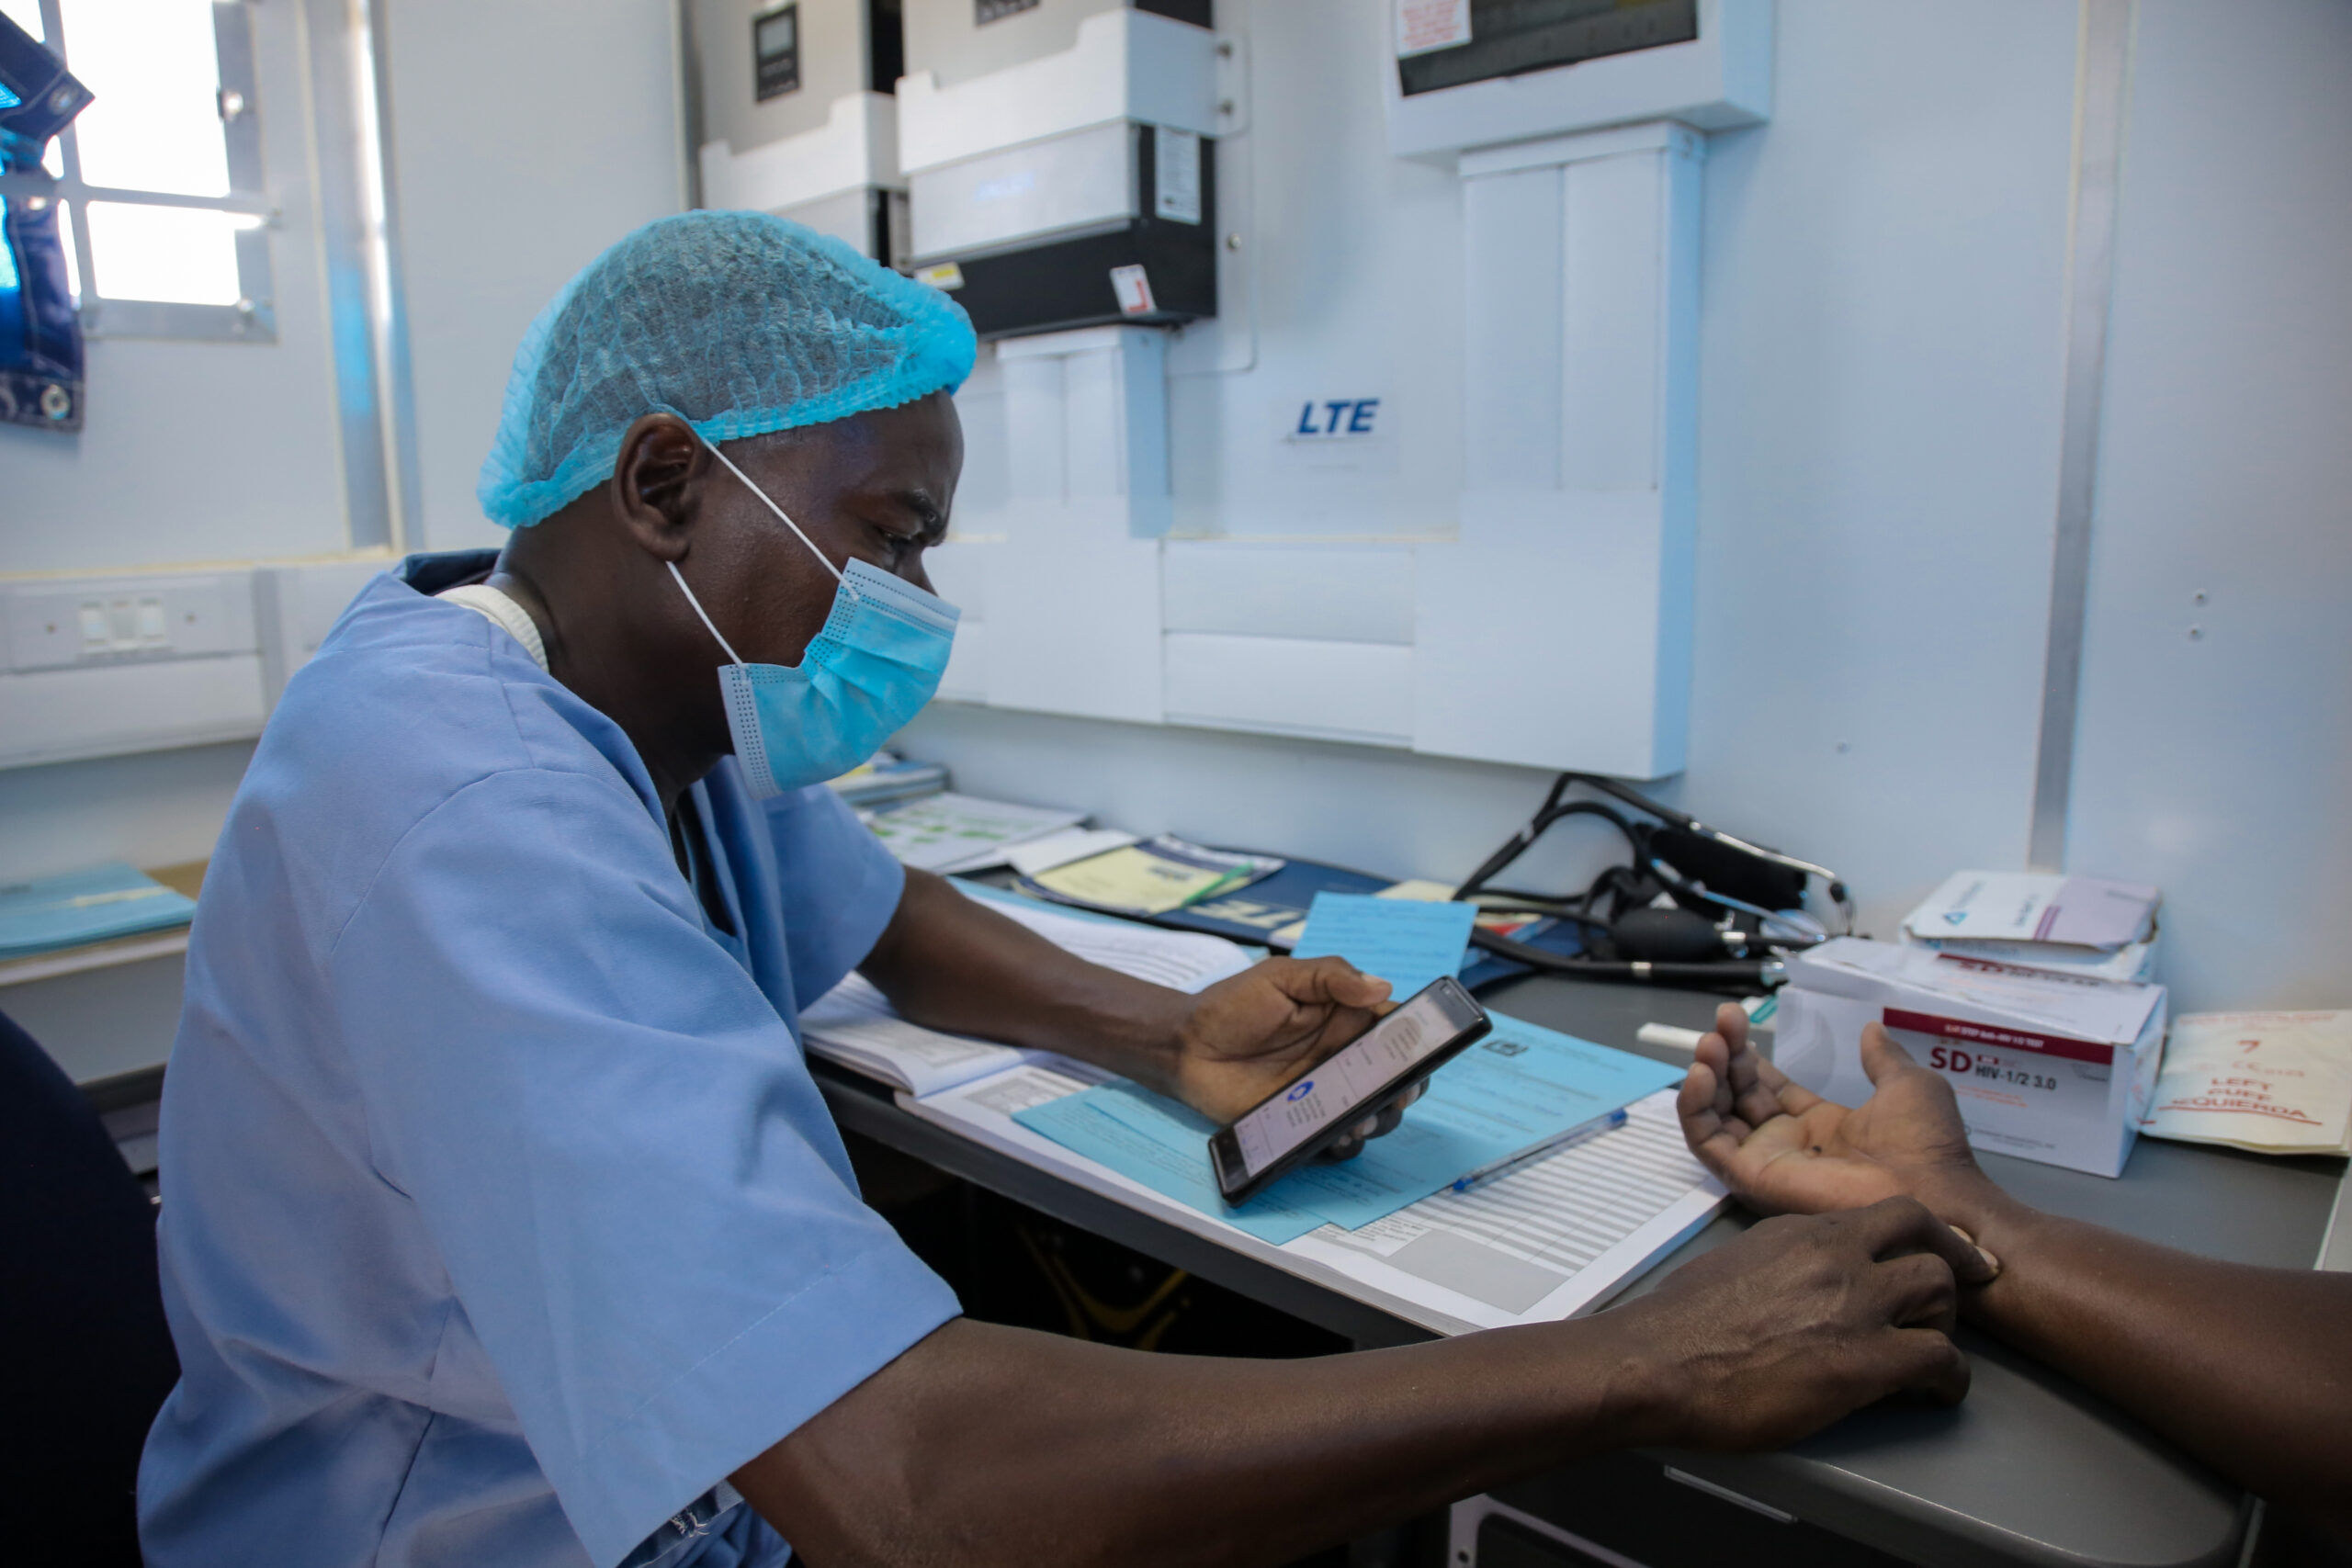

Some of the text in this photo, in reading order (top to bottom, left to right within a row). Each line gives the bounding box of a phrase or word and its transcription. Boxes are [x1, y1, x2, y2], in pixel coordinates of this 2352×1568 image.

[1297, 398, 1380, 434] LTE
[1930, 1046, 1973, 1073] SD
[1975, 1064, 2030, 1086] HIV-1/2
[2033, 1075, 2057, 1091] 3.0
[2211, 1077, 2273, 1092] LEFT
